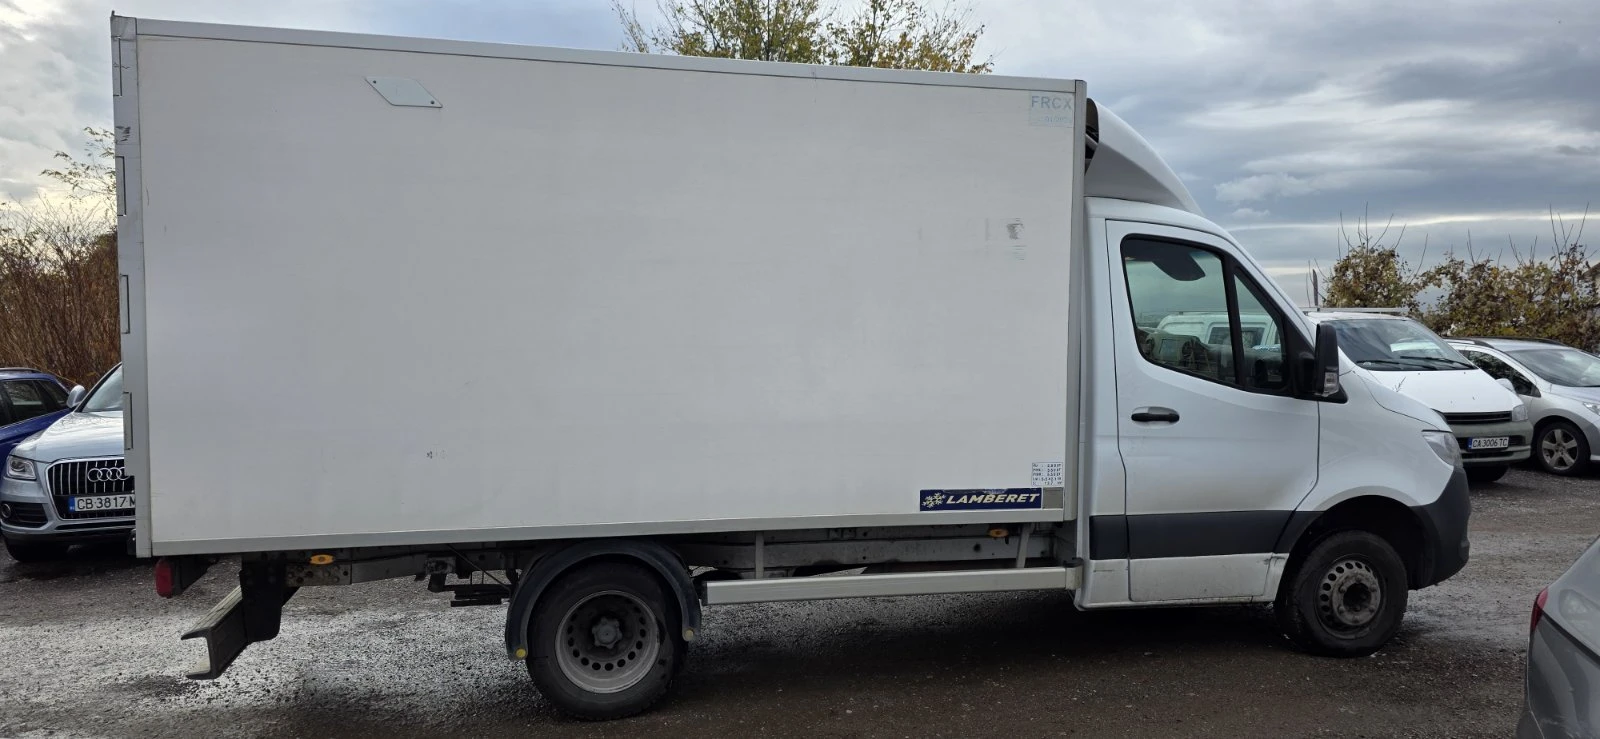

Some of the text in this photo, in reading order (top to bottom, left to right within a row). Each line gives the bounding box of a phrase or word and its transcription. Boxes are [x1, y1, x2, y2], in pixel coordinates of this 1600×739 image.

[1031, 95, 1072, 110] FRCX
[77, 498, 94, 510] CB
[96, 496, 127, 509] 3817
[945, 493, 1040, 505] LAMBERET
